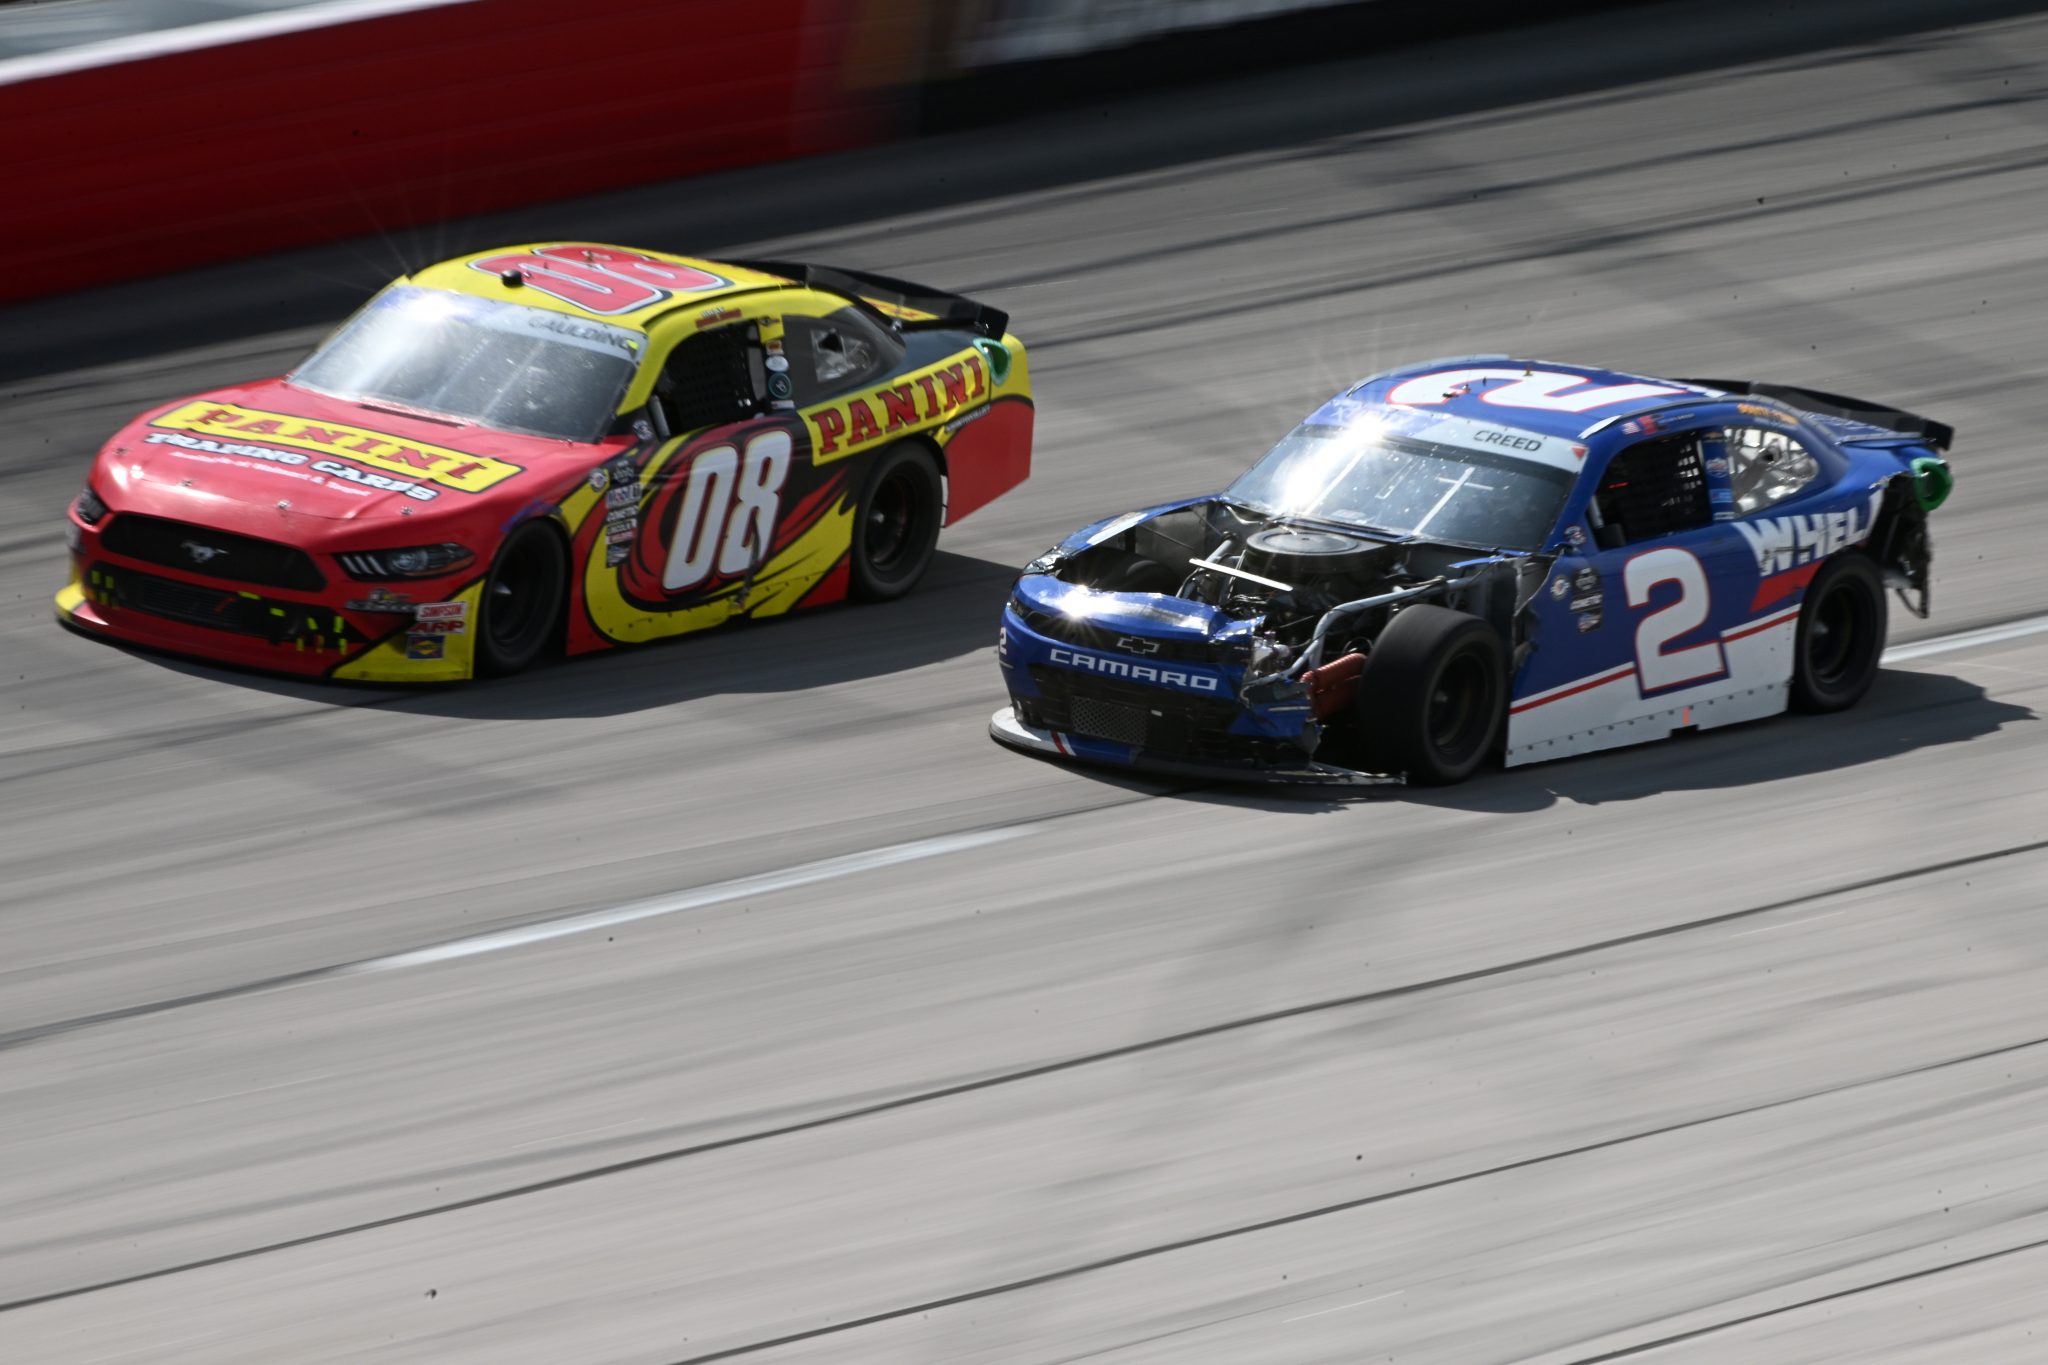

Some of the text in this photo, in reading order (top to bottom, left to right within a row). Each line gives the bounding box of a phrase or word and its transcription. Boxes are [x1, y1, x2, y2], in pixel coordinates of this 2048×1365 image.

[810, 355, 986, 457] PANINI
[1386, 368, 1690, 413] 2
[145, 432, 441, 501] TRADING CARDS
[185, 408, 491, 481] PANINI
[1473, 429, 1543, 452] CREED
[661, 429, 794, 592] 08
[1731, 490, 1884, 577] WHEL
[409, 620, 465, 633] ARP
[422, 605, 464, 618] SIMPSON
[1623, 545, 1730, 697] 2
[1050, 648, 1219, 691] CAMARO
